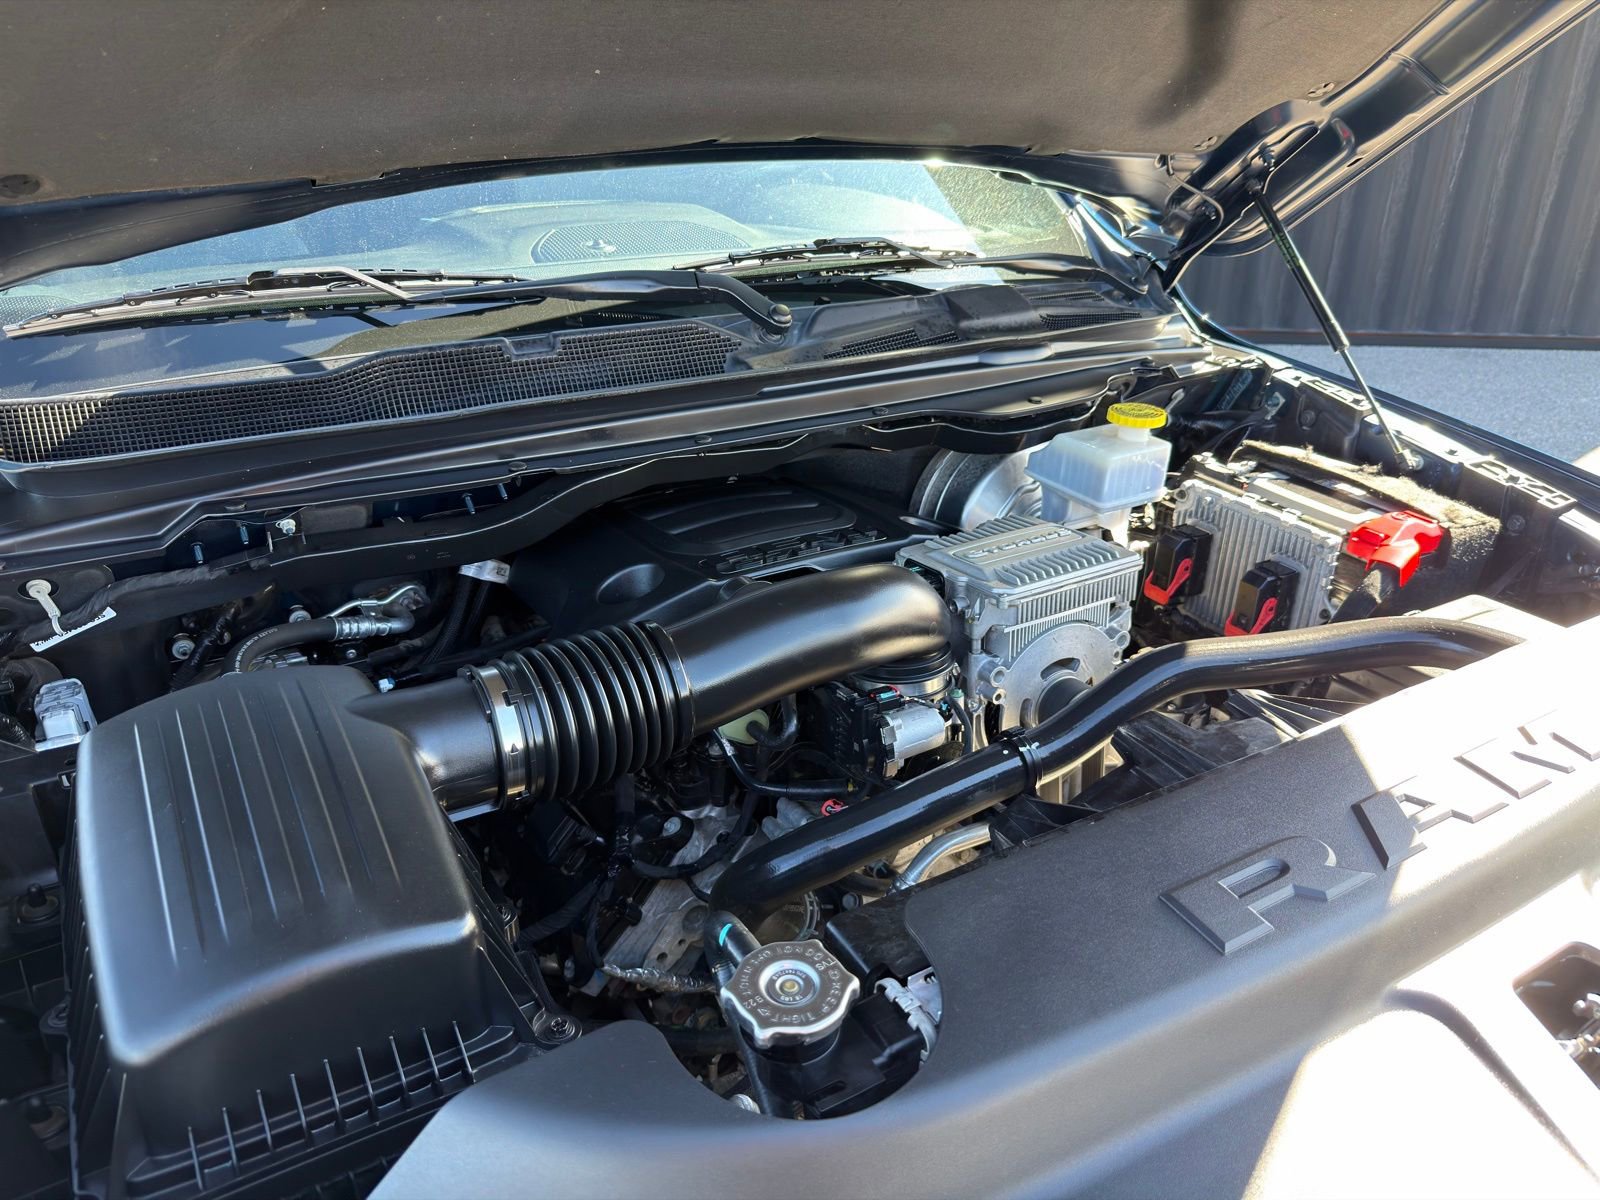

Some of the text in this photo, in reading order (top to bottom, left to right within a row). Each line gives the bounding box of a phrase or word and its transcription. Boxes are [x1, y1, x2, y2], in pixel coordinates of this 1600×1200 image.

[1158, 708, 1600, 955] RAM
[815, 956, 838, 971] TVS
[770, 981, 842, 1025] KEEP TIGHT
